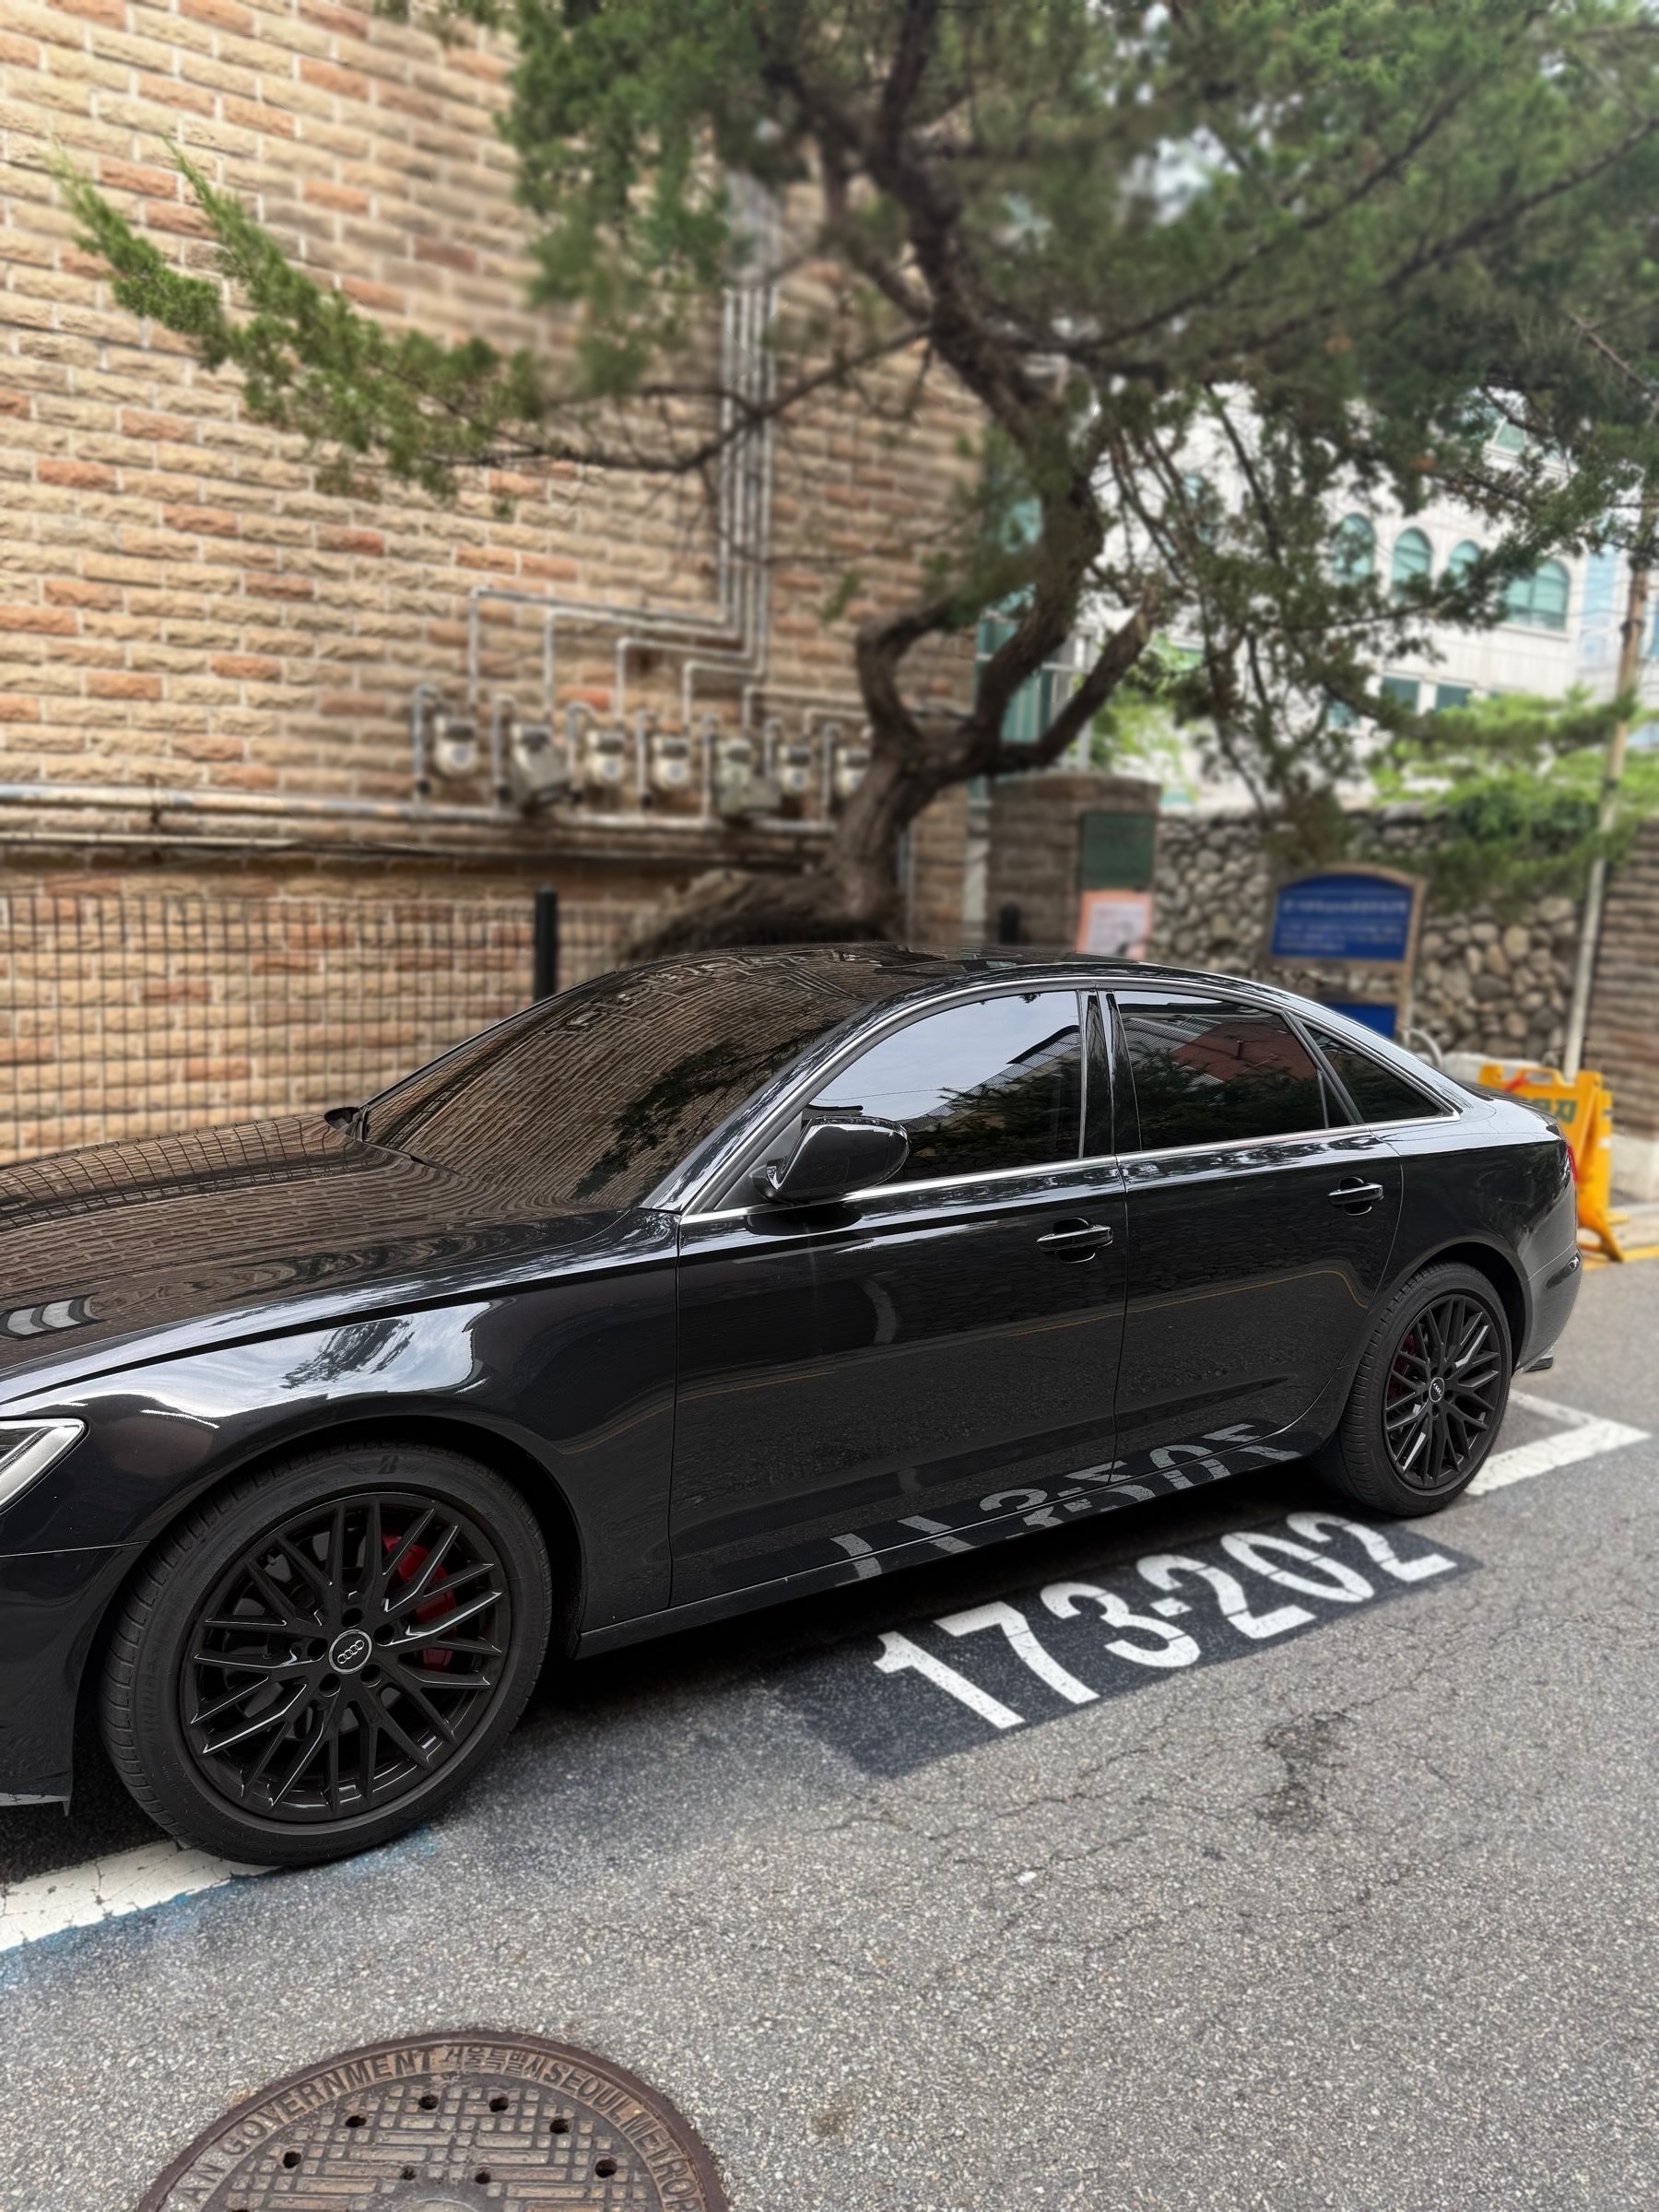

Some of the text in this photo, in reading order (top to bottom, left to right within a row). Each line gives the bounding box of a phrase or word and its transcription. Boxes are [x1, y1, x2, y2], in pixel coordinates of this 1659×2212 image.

[872, 1512, 1457, 1730] 173-202
[221, 2047, 435, 2156] GOVERNMENT
[442, 2045, 548, 2083] 서울특별시
[544, 2062, 633, 2122] SEOUL
